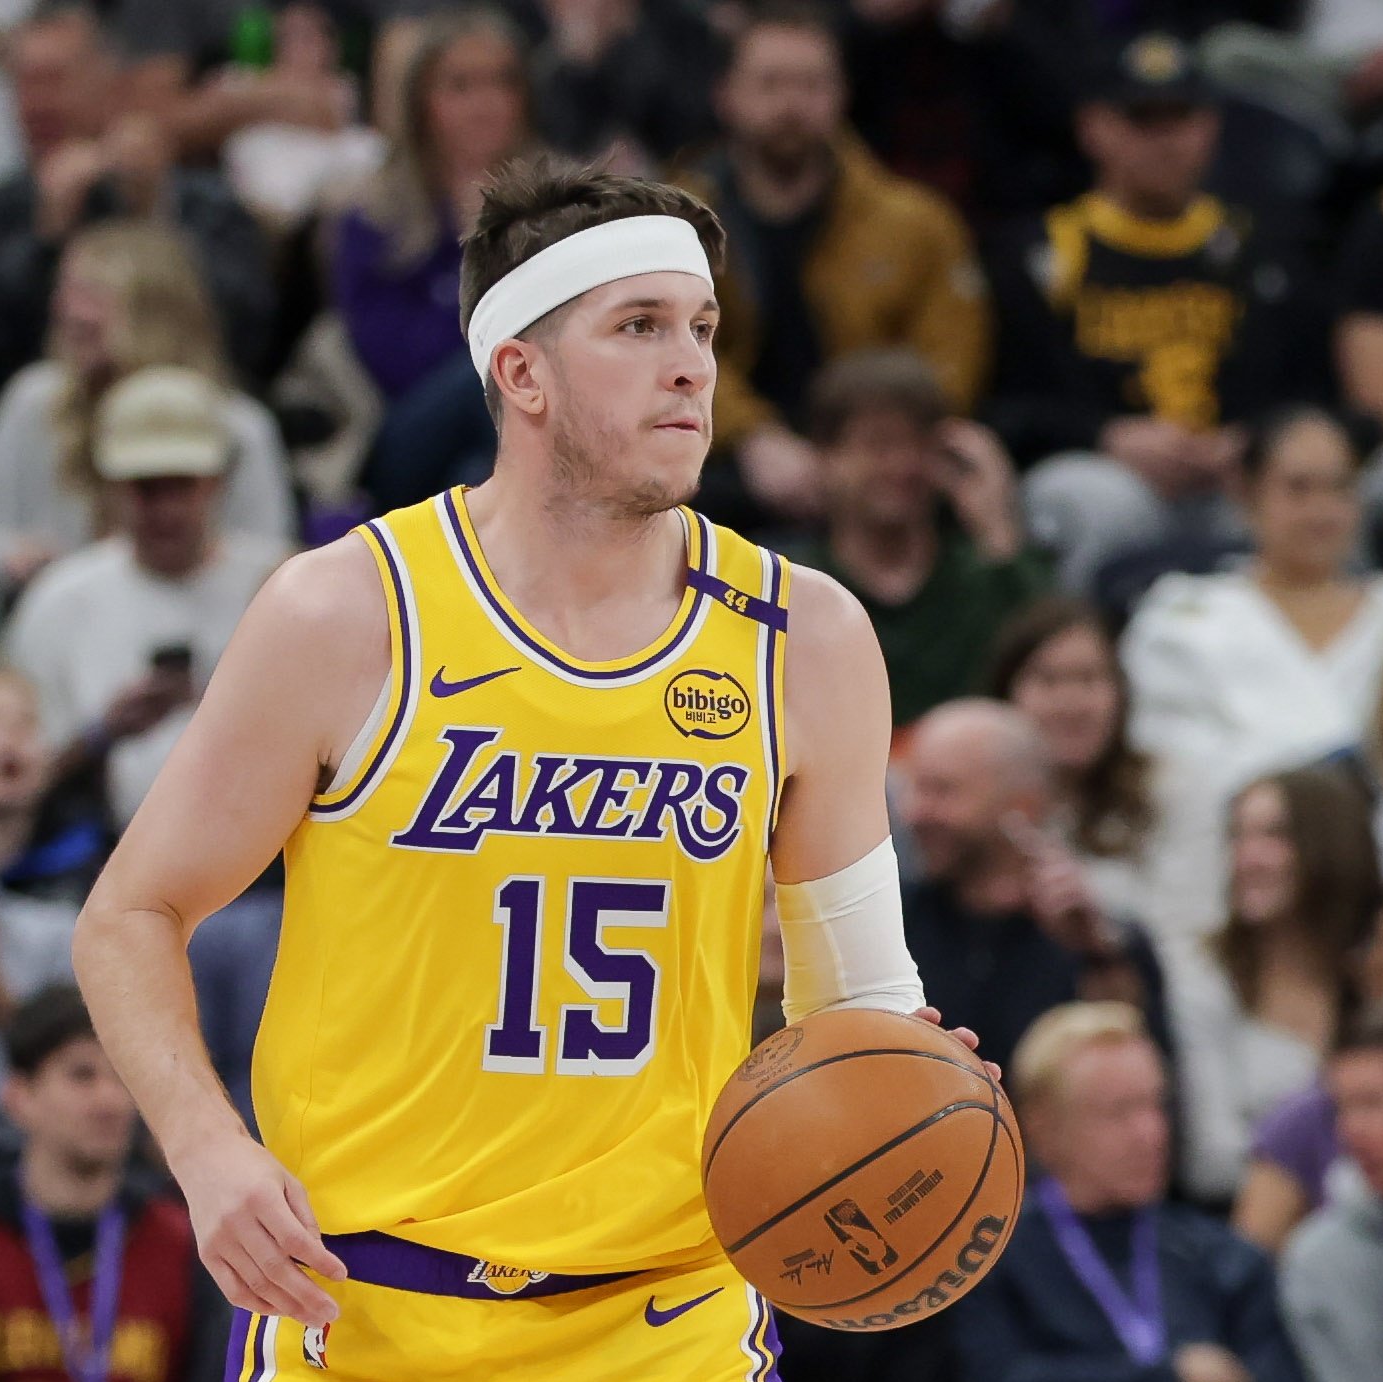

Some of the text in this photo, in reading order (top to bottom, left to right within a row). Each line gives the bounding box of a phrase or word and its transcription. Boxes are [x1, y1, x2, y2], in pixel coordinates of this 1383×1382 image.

[724, 588, 749, 613] 44
[672, 686, 745, 720] bibigo
[685, 710, 717, 724] 비비고
[389, 725, 752, 863] LAKERS
[482, 873, 672, 1076] 15
